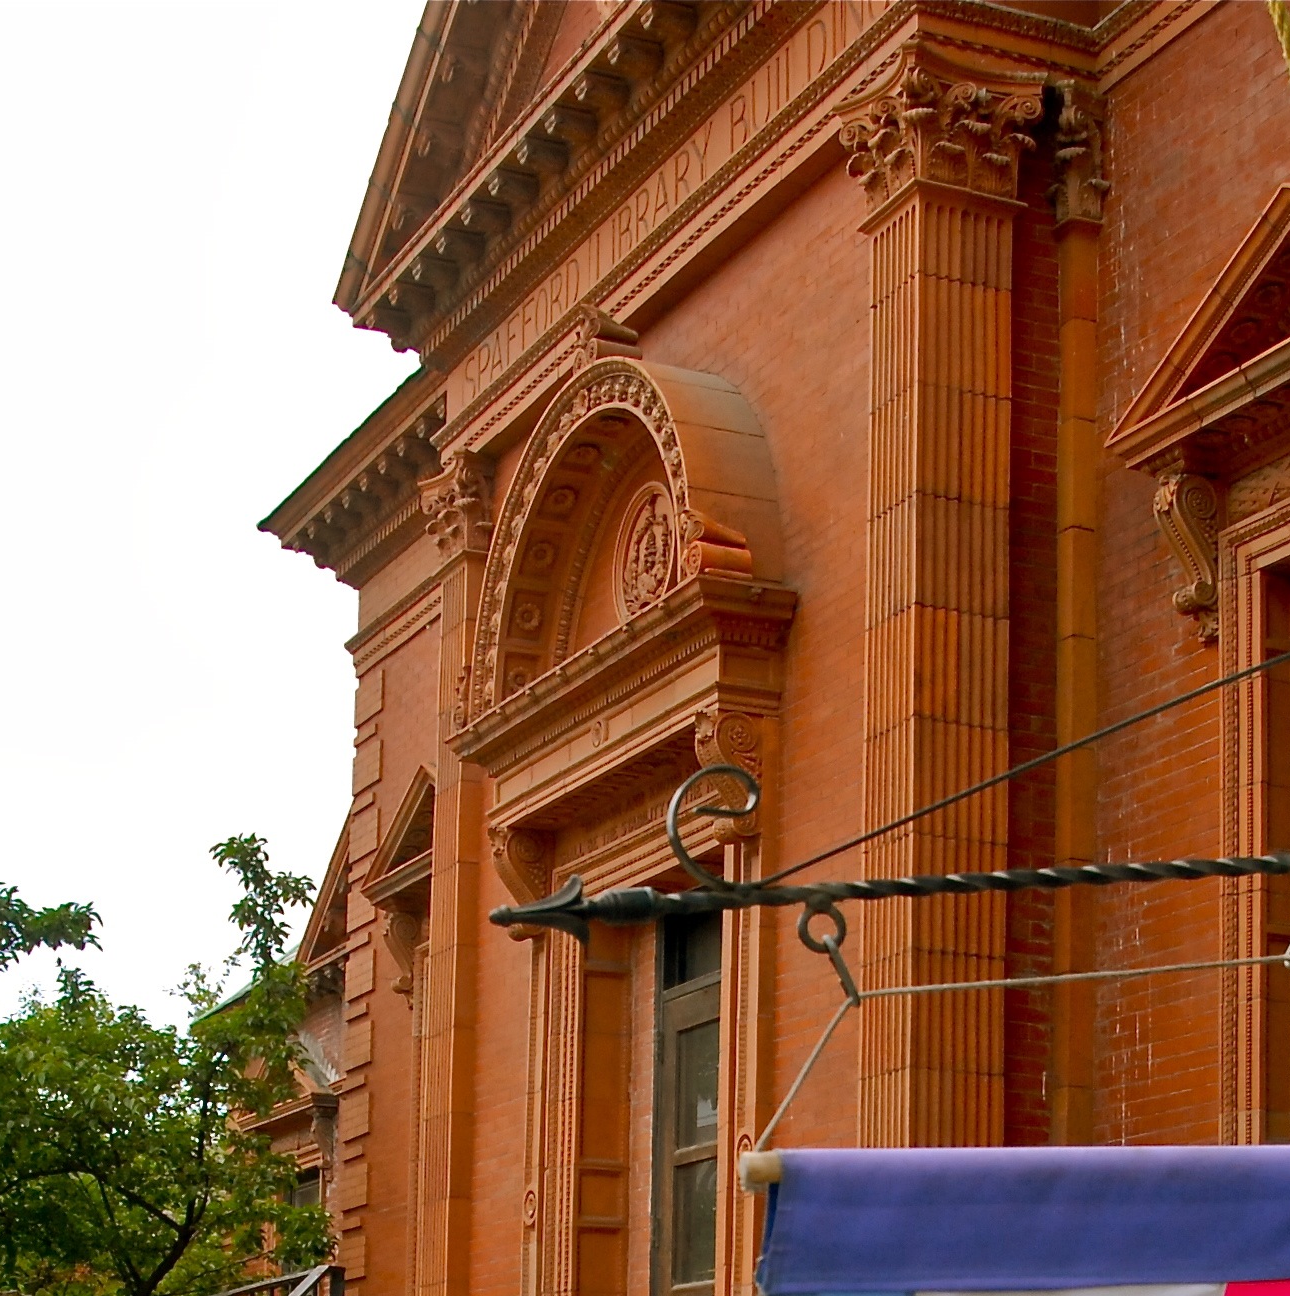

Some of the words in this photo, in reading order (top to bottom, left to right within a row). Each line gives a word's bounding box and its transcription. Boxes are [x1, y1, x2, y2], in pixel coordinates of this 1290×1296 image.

[465, 259, 580, 399] SPAFFORD
[595, 121, 713, 281] LIBRARY
[729, 0, 890, 153] BUILDIN
